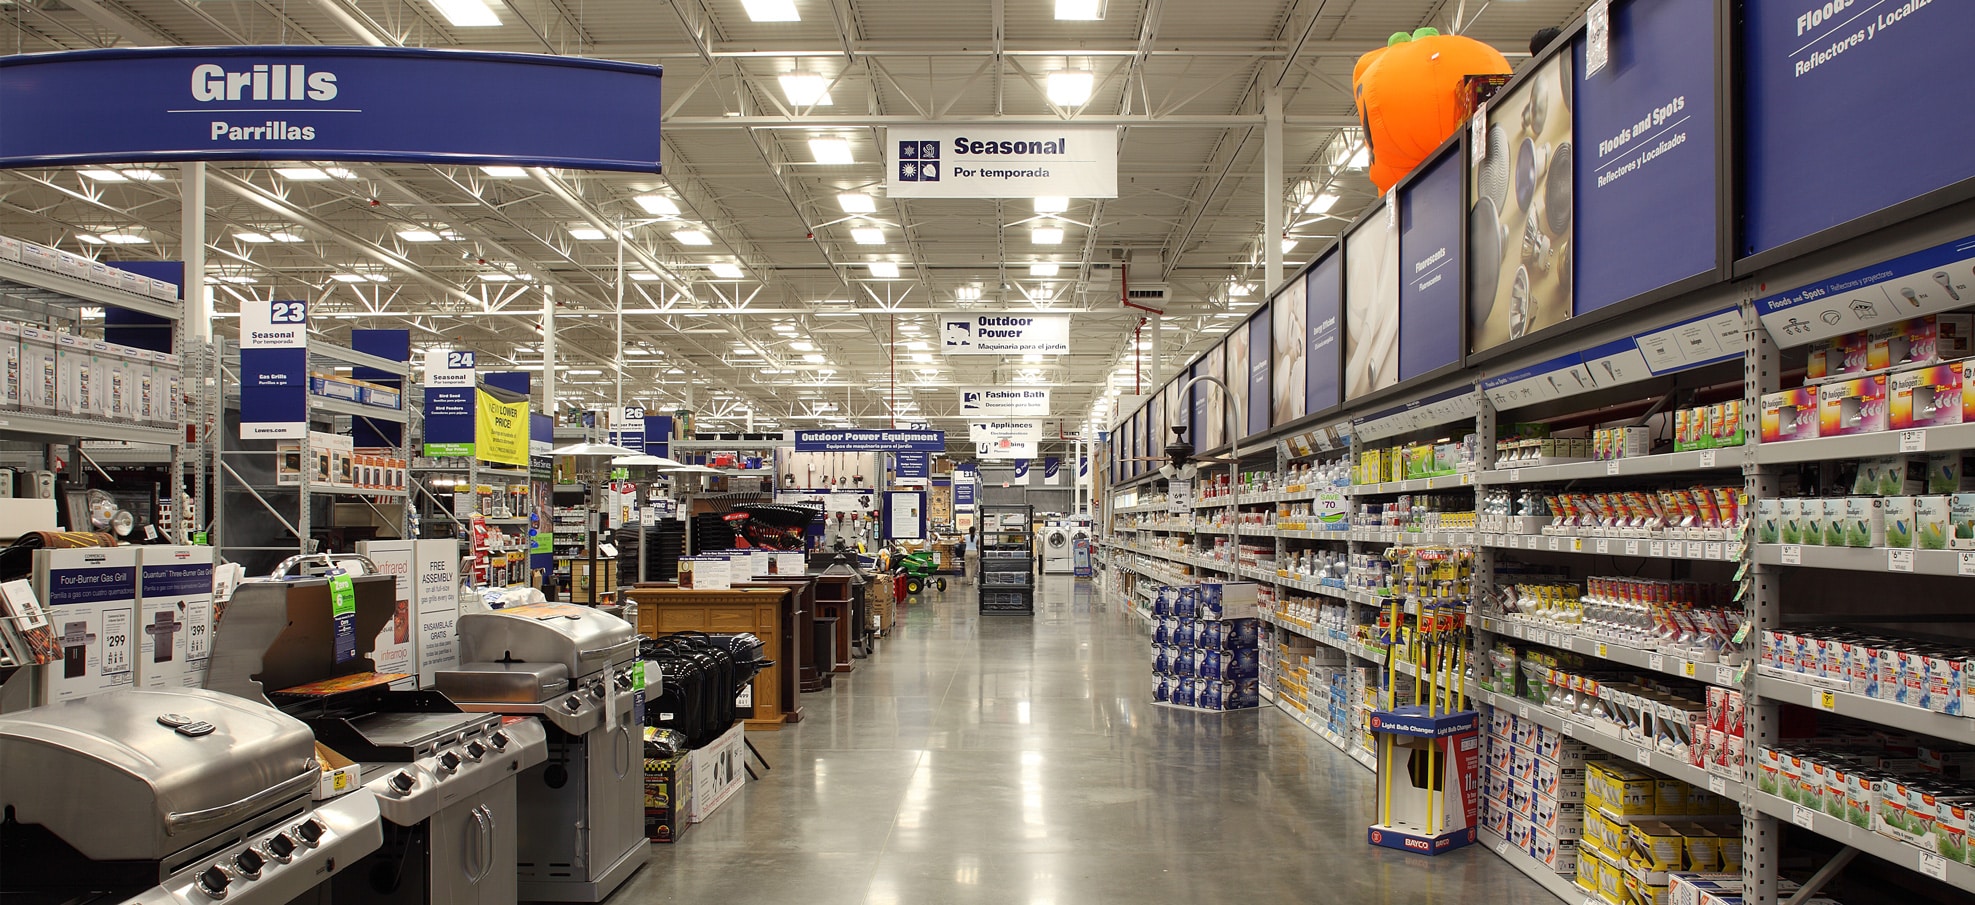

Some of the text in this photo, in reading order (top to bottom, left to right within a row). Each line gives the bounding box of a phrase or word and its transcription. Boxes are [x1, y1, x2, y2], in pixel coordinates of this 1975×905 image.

[1795, 29, 1865, 77] Reflectores
[1867, 23, 1876, 40] y
[191, 64, 338, 102] Grills
[211, 121, 316, 141] Parrillas
[1599, 96, 1685, 158] Floods and Spots
[954, 137, 1065, 155] Seasonal
[1597, 132, 1686, 188] Reflectores y Localizados
[954, 167, 1050, 180] Por temporada
[1415, 247, 1446, 274] Fluorescents
[1767, 298, 1792, 310] Floods
[1793, 295, 1802, 303] and
[1802, 288, 1825, 301] Spots
[1830, 279, 1859, 292] Reflectores
[1862, 270, 1893, 284] proyectores
[272, 303, 305, 322] 23
[978, 316, 1034, 326] Outdoor
[252, 331, 295, 339] Seasonal
[978, 328, 1023, 338] Power
[978, 343, 1018, 351] Maquinaria
[449, 352, 473, 367] 24
[1899, 380, 1917, 389] halogen
[1828, 389, 1846, 399] halogen
[500, 406, 518, 419] LOWER
[626, 408, 644, 418] 26
[495, 416, 511, 429] PRICE!
[990, 422, 1032, 430] Appliances
[802, 433, 938, 443] Outdoor Power Equipment
[994, 441, 1025, 449] Pbing
[1322, 501, 1336, 509] $70
[378, 560, 408, 575] infrared
[430, 561, 446, 571] FREE
[60, 572, 127, 585] Four-Burner Gas Grill
[169, 569, 197, 578] Three-Burner
[422, 572, 454, 584] ASSEMBLY
[335, 581, 349, 590] Zero
[50, 591, 67, 599] Parrilla
[72, 592, 82, 600] gas
[82, 590, 92, 598] con
[108, 588, 135, 596] quemadores
[190, 624, 205, 636] $399
[423, 620, 453, 632] ENSAMBLAJE
[106, 634, 126, 647] $299
[430, 631, 447, 641] GRATIS
[381, 647, 408, 660] infrarrojo
[1381, 722, 1434, 735] Light Bulb Changer
[1457, 724, 1472, 732] Changer
[1405, 838, 1429, 850] BAYCO
